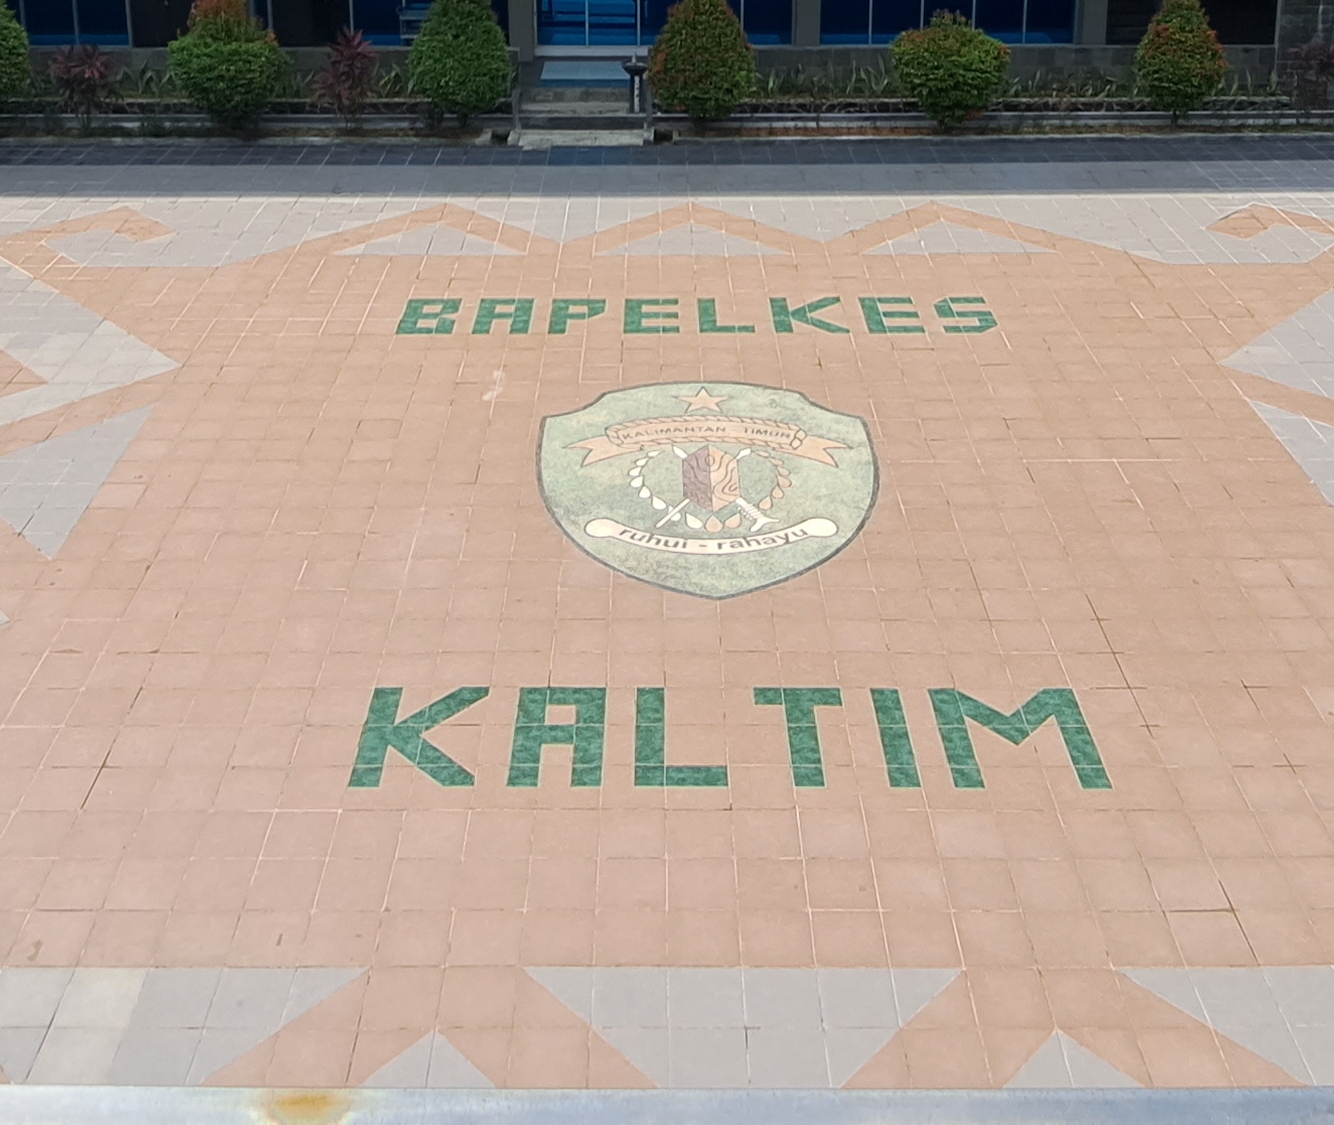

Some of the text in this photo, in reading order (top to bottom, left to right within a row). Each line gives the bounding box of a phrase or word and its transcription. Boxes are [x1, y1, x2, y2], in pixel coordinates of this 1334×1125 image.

[395, 297, 999, 335] BAPELKES
[622, 426, 726, 440] KALIMANTAN
[619, 528, 688, 549] ruhui
[717, 529, 808, 550] rahayu
[348, 686, 1113, 790] KALTIM
